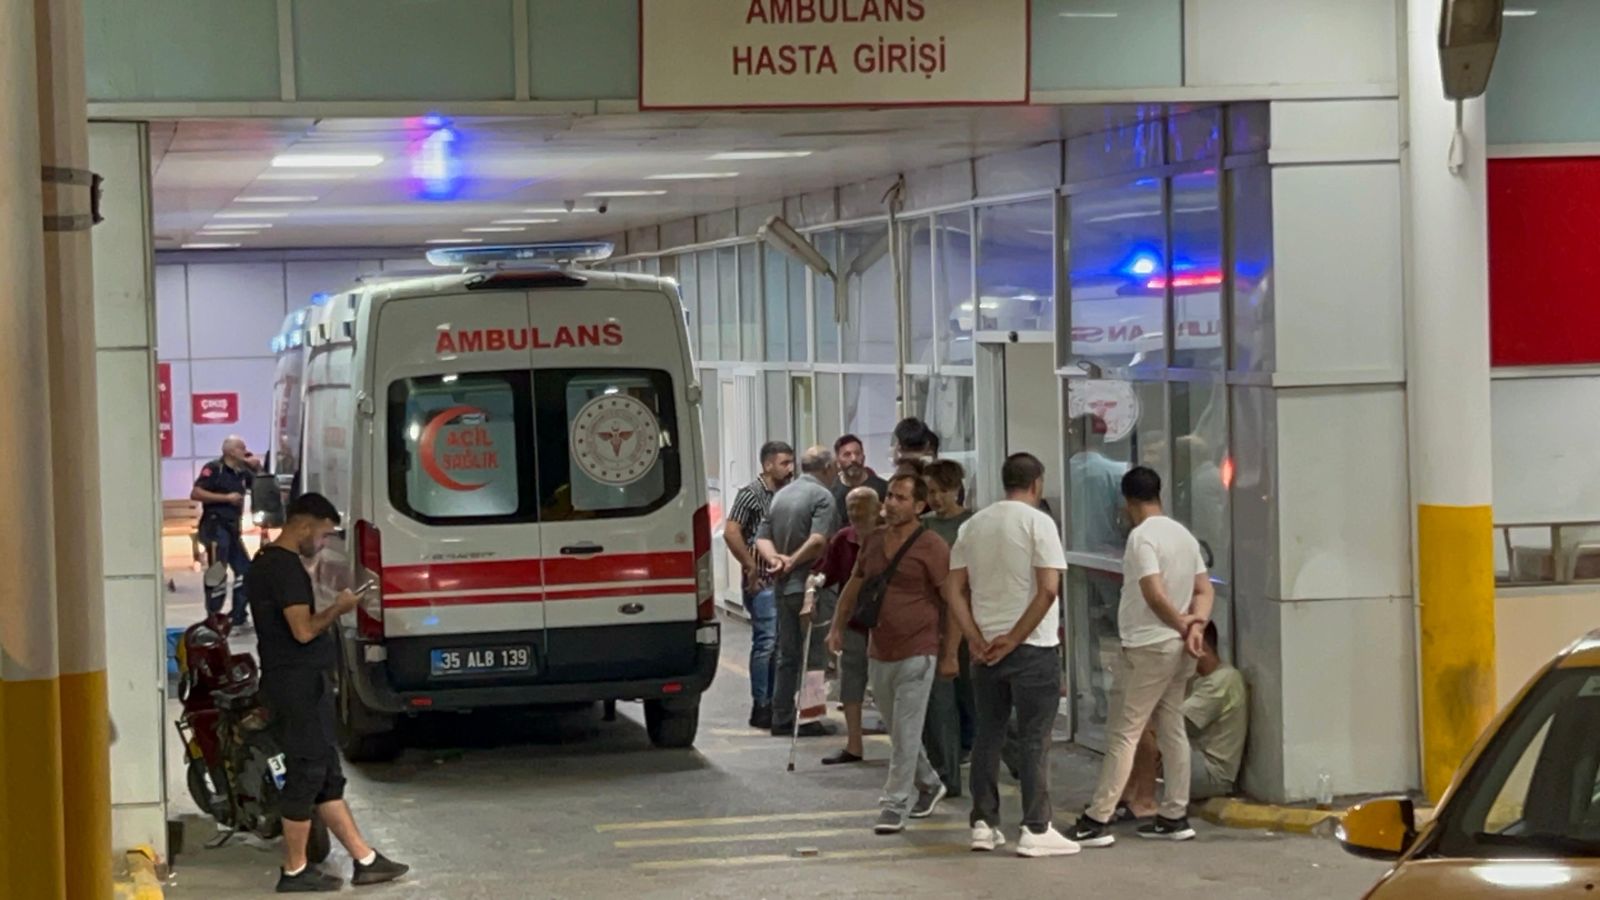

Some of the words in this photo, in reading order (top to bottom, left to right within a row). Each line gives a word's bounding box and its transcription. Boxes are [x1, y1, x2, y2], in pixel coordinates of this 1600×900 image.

[745, 0, 926, 24] AMBULANS
[732, 45, 838, 75] HASTA
[853, 36, 947, 79] GİRİŞİ
[436, 323, 623, 353] AMBULANS
[441, 652, 461, 669] 35
[467, 650, 495, 668] ALB
[502, 649, 528, 666] 139
